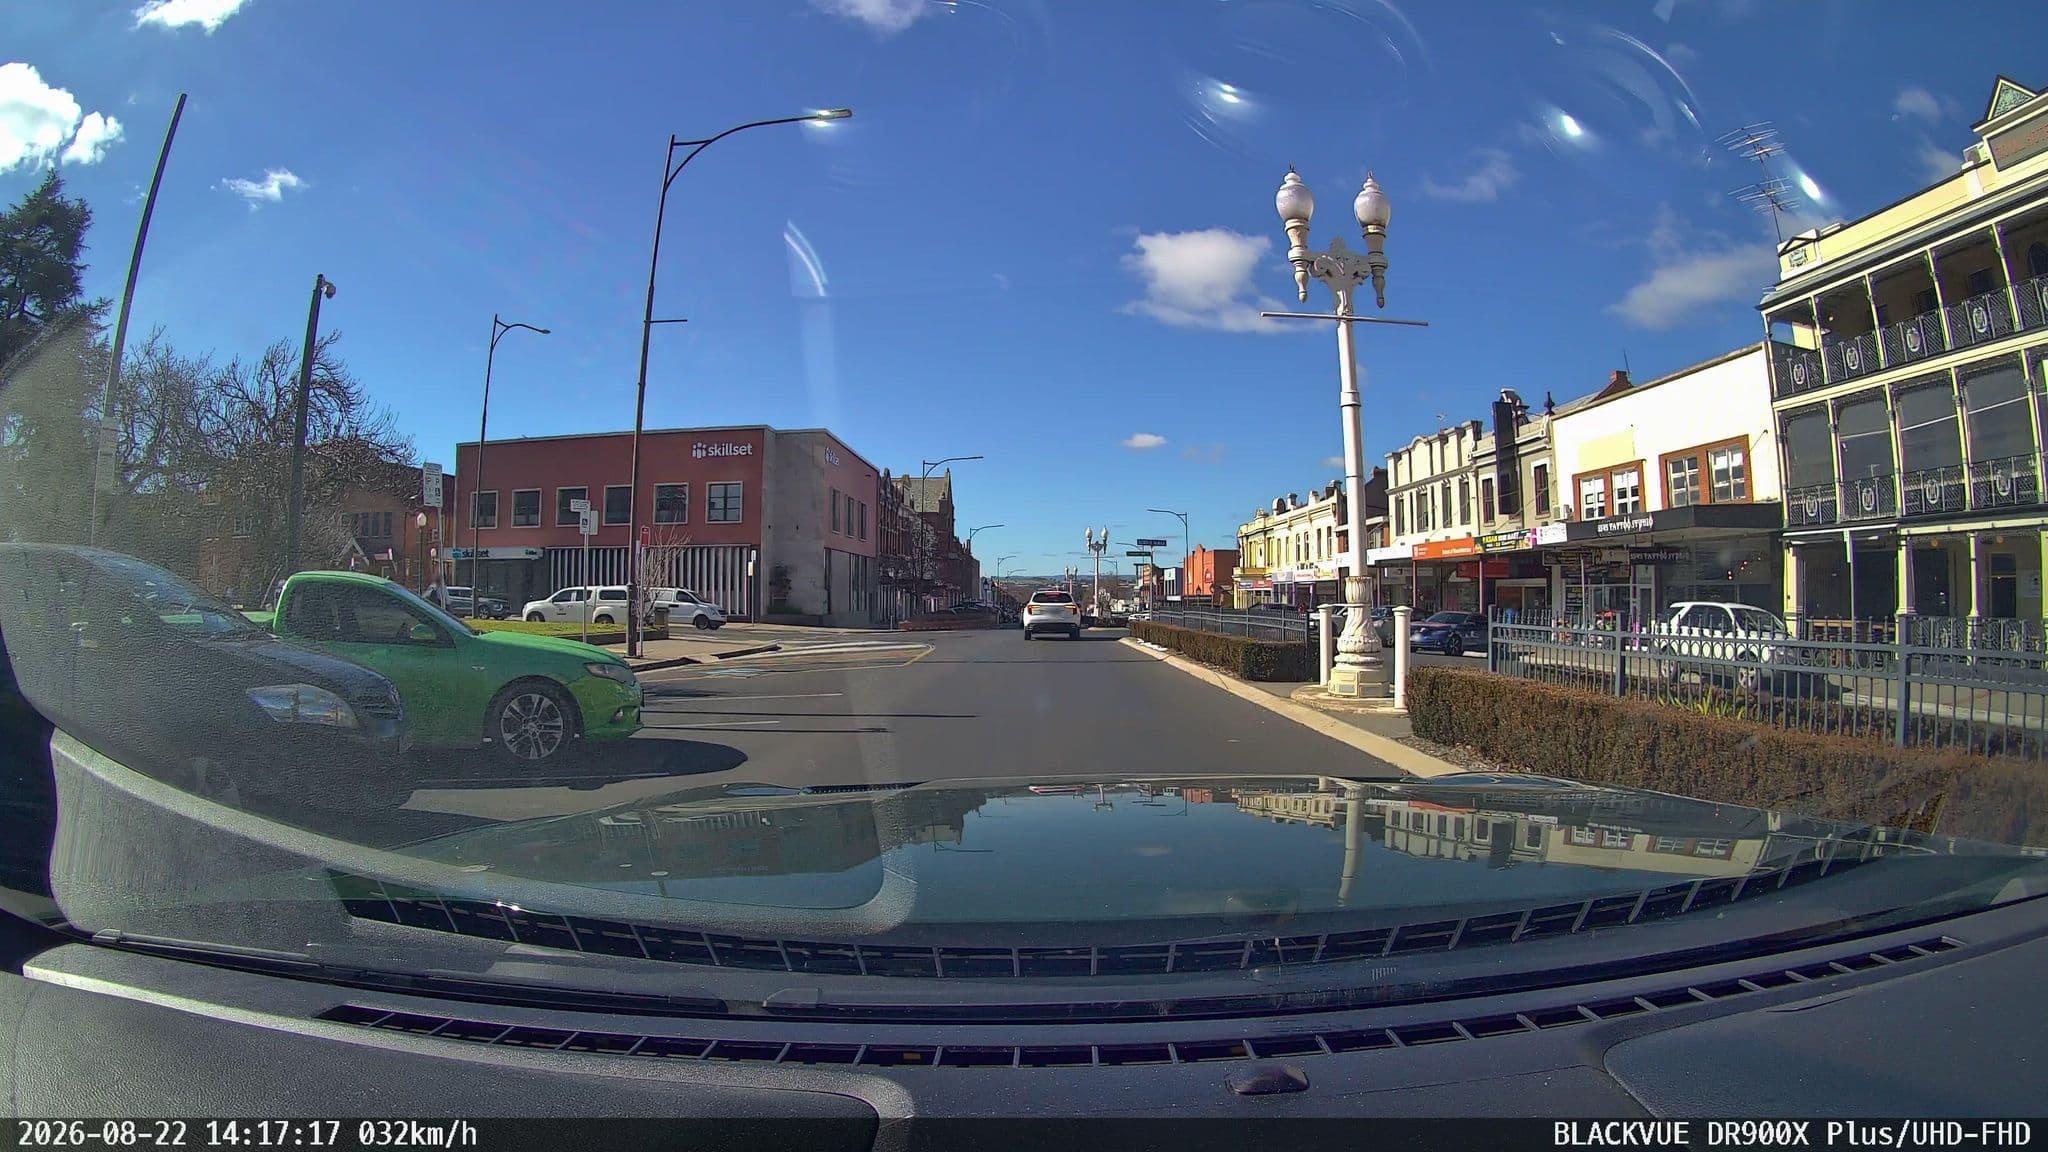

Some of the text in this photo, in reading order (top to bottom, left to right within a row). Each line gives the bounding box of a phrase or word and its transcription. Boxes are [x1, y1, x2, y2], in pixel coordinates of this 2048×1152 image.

[708, 442, 752, 456] skillset
[1609, 515, 1631, 532] TATTOO
[1631, 513, 1654, 531] STUDIO
[462, 548, 489, 558] skilset
